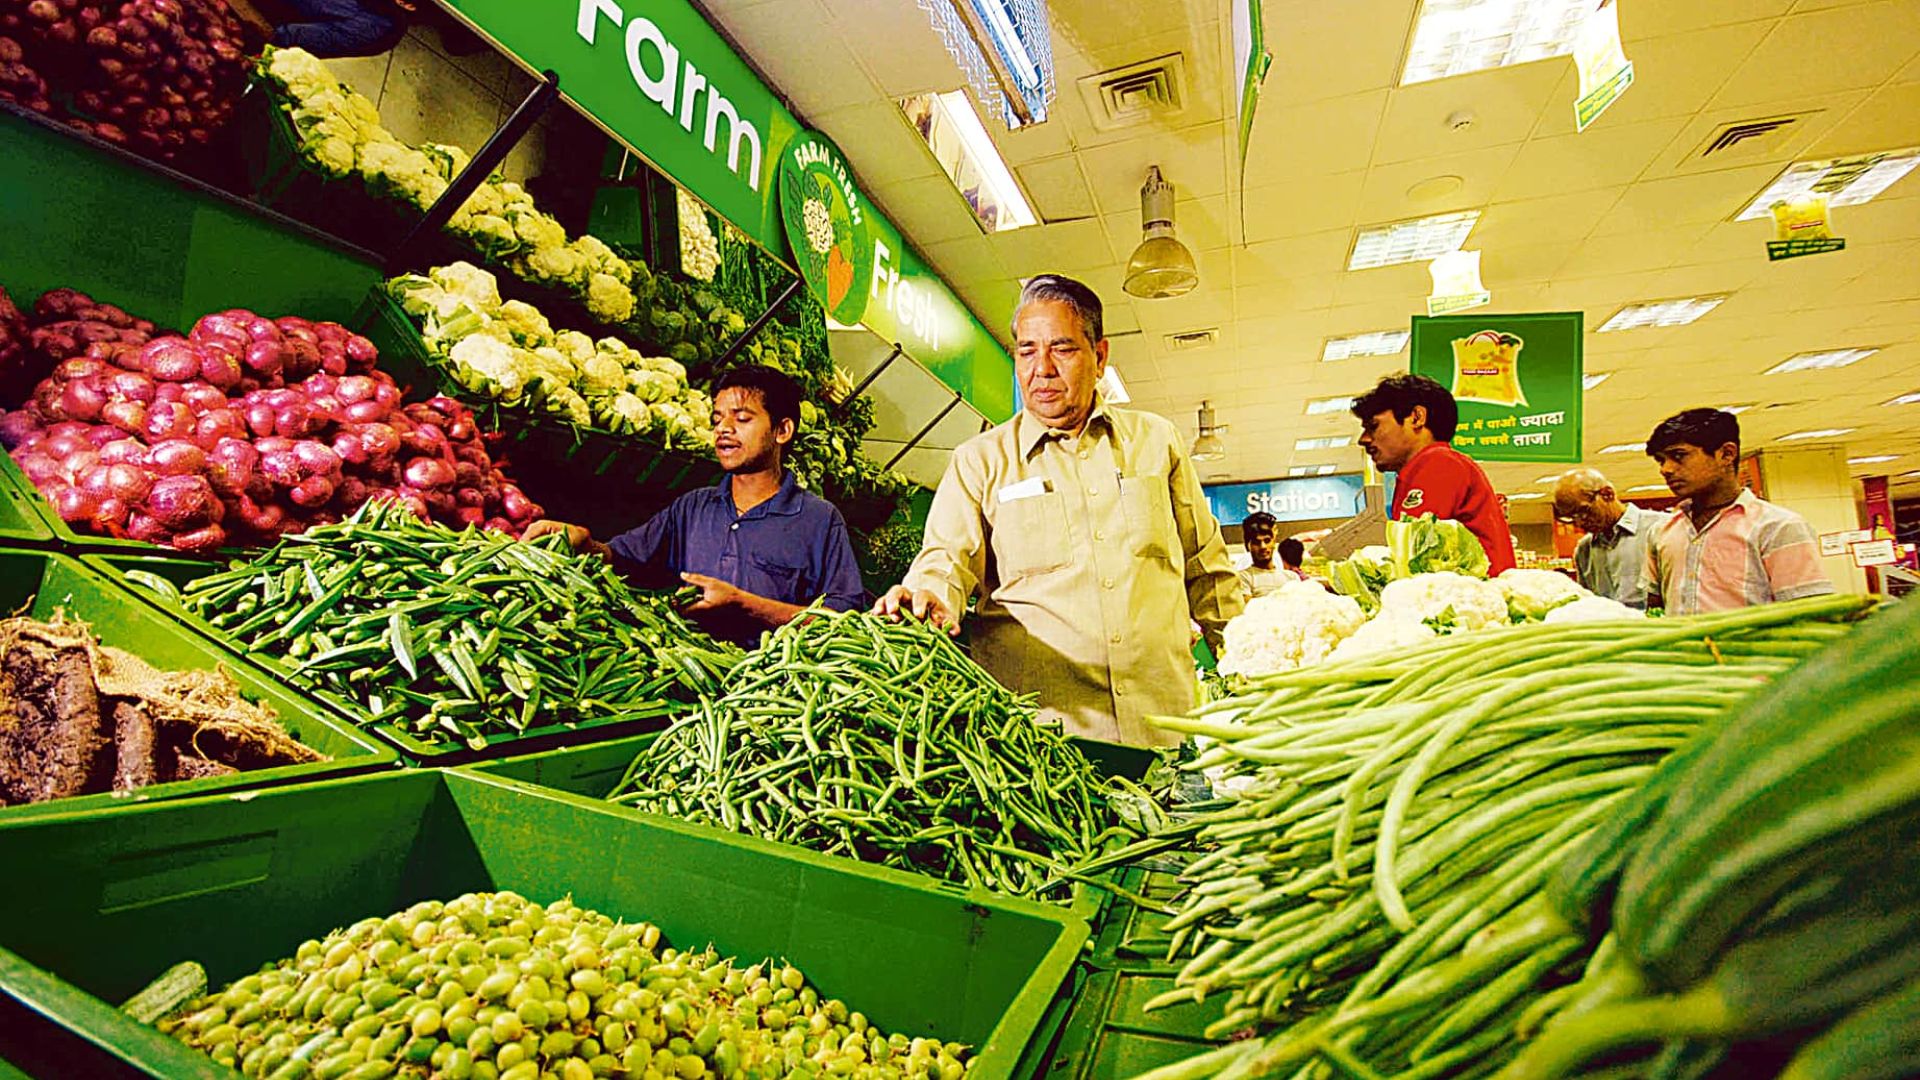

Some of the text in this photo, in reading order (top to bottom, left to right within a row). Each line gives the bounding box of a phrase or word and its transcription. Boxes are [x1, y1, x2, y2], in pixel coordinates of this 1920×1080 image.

[794, 141, 862, 225] FARM FRESH
[872, 237, 940, 351] Fresh
[1520, 411, 1565, 427] ज्यादा
[1512, 432, 1552, 447] ताजा
[1246, 491, 1339, 514] Station
